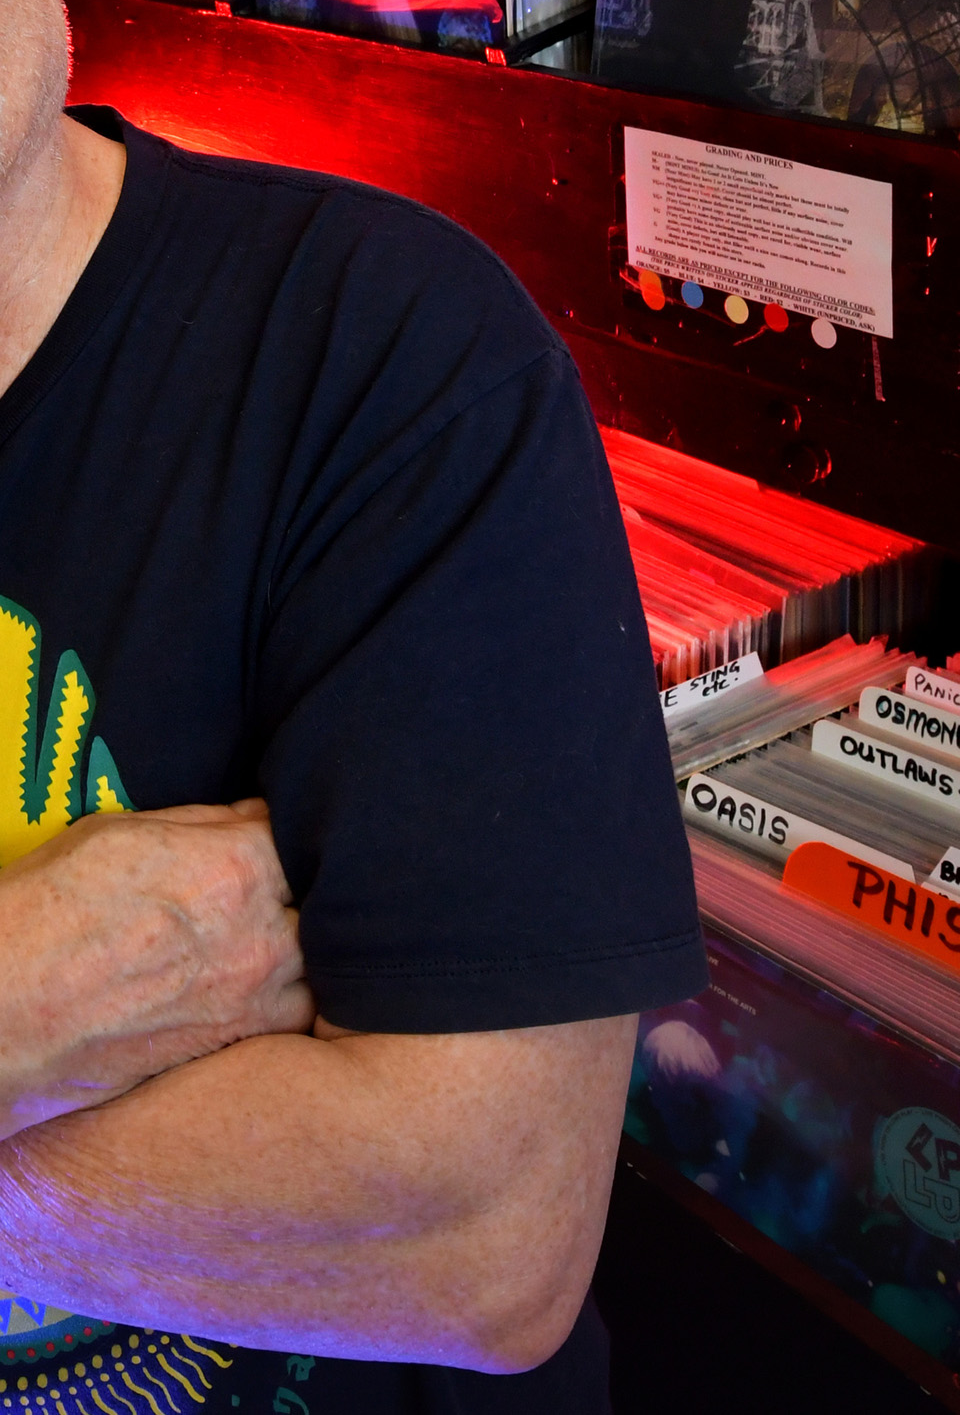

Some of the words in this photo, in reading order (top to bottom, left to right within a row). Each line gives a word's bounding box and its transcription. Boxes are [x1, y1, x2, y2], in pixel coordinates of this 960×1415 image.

[704, 144, 743, 159] GRADING
[744, 152, 762, 164] AND
[762, 156, 794, 170] PRICES
[634, 243, 648, 254] ALL
[648, 247, 677, 262] RECORDS
[677, 255, 689, 265] ARE
[689, 258, 699, 268] AS
[699, 260, 723, 274] PRICED
[723, 267, 750, 281] EXCEPT
[749, 274, 764, 286] FOR
[764, 278, 778, 289] THE
[778, 282, 823, 301] FOLLOWING
[822, 294, 848, 308] COLOR
[680, 264, 706, 276] WRITTEN
[714, 273, 739, 285] STICKER
[739, 280, 763, 292] APPLIES
[763, 287, 802, 303] REGARDLESS
[811, 300, 838, 313] STICKER
[792, 303, 816, 315] WHITE
[815, 309, 858, 327] (UNPRICED,
[857, 321, 876, 332] ASK)
[689, 660, 741, 692] STING
[839, 736, 954, 796] OUTLAWS
[690, 783, 790, 845] OASIS
[739, 1002, 757, 1016] ARTS
